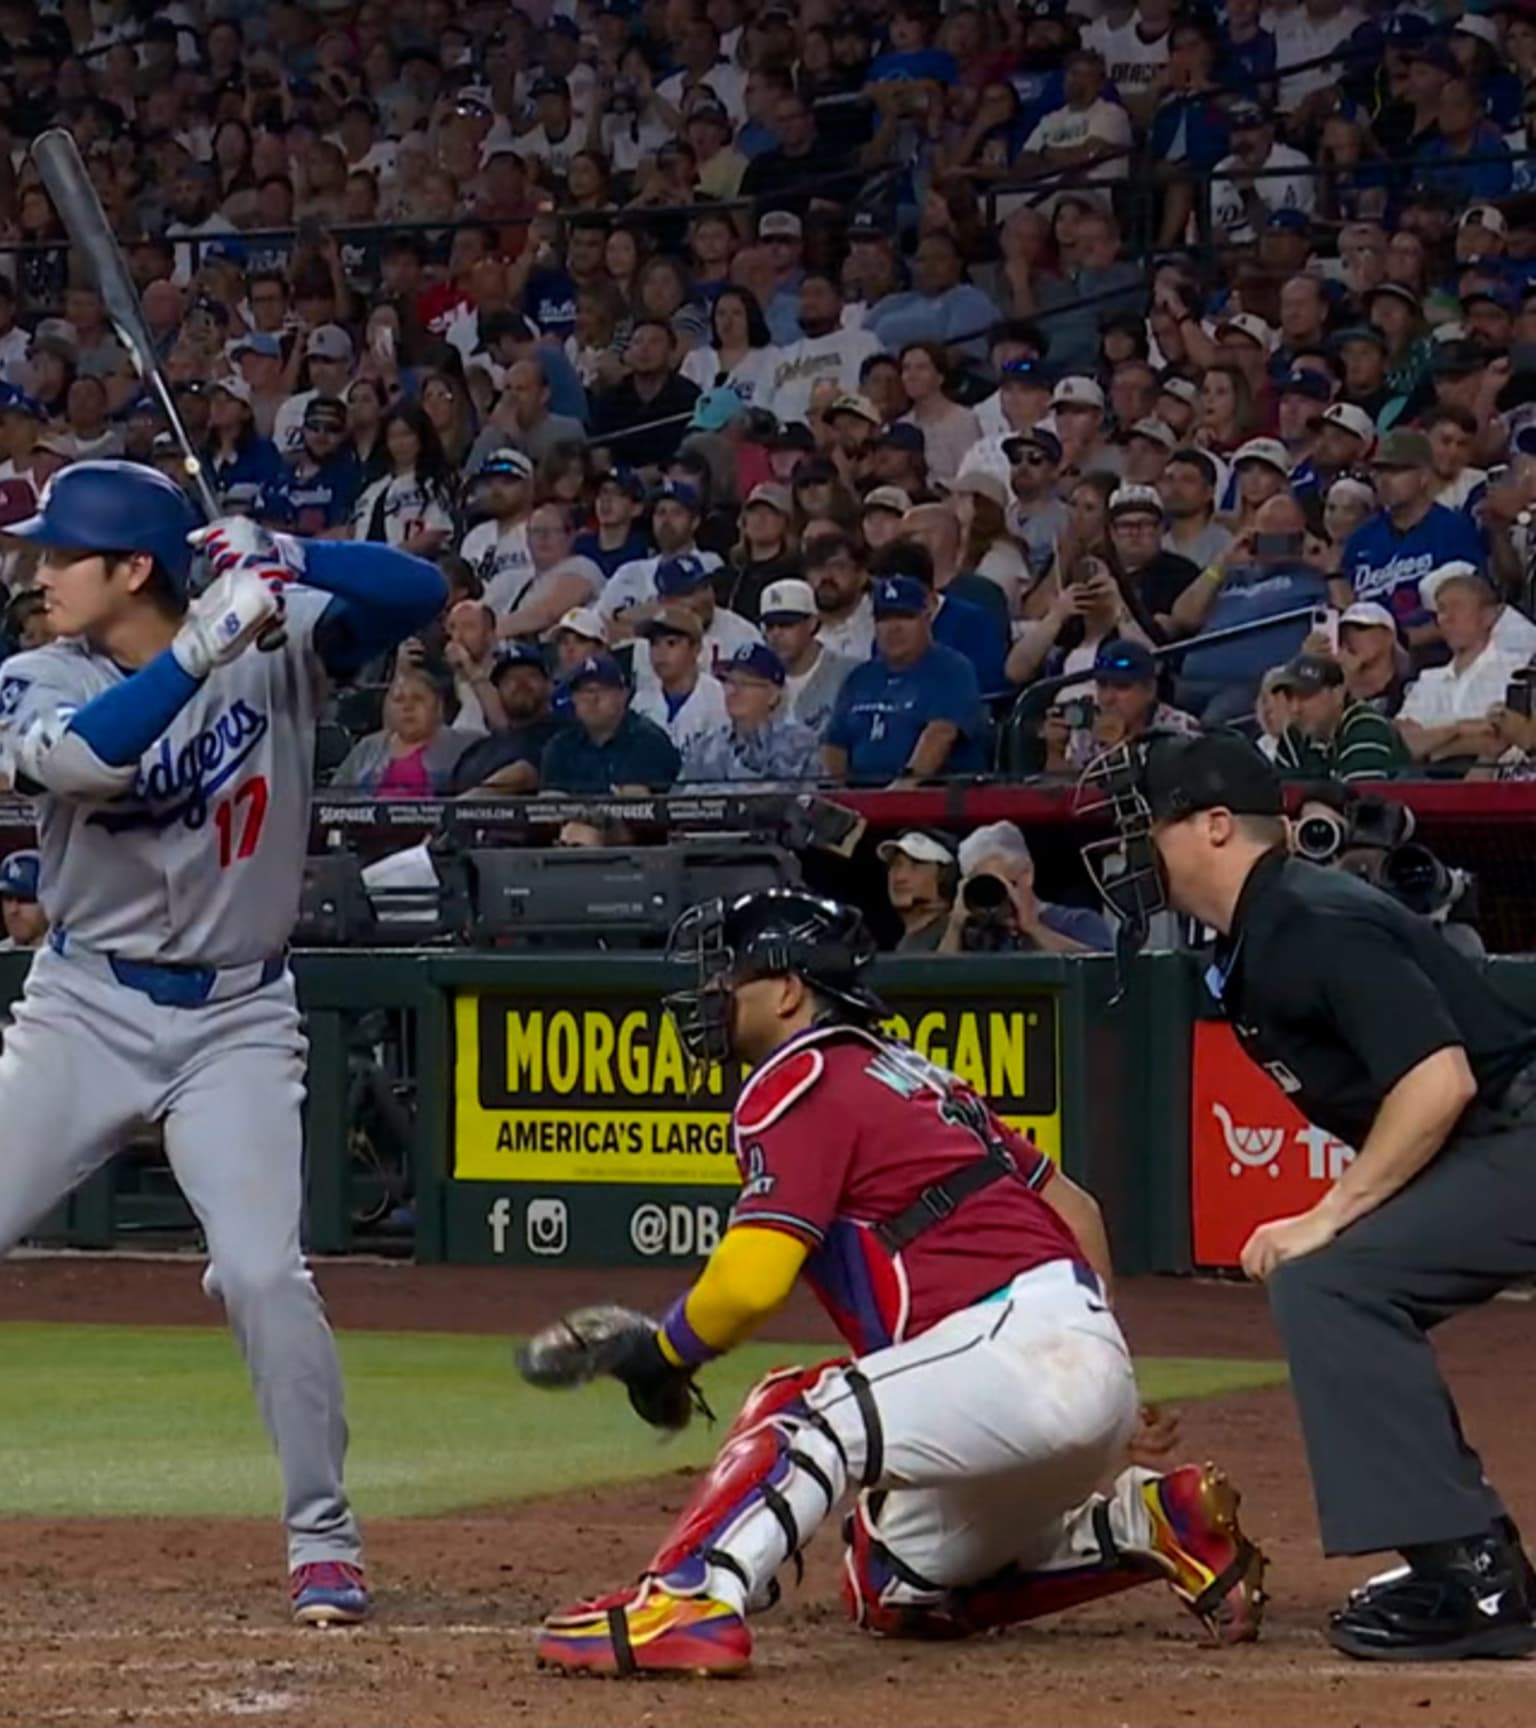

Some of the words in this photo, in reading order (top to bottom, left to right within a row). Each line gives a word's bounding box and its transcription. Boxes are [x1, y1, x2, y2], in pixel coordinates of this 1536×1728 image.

[215, 775, 268, 868] 17
[495, 1121, 642, 1153] AMERICA'S
[629, 1204, 730, 1257] @DB
